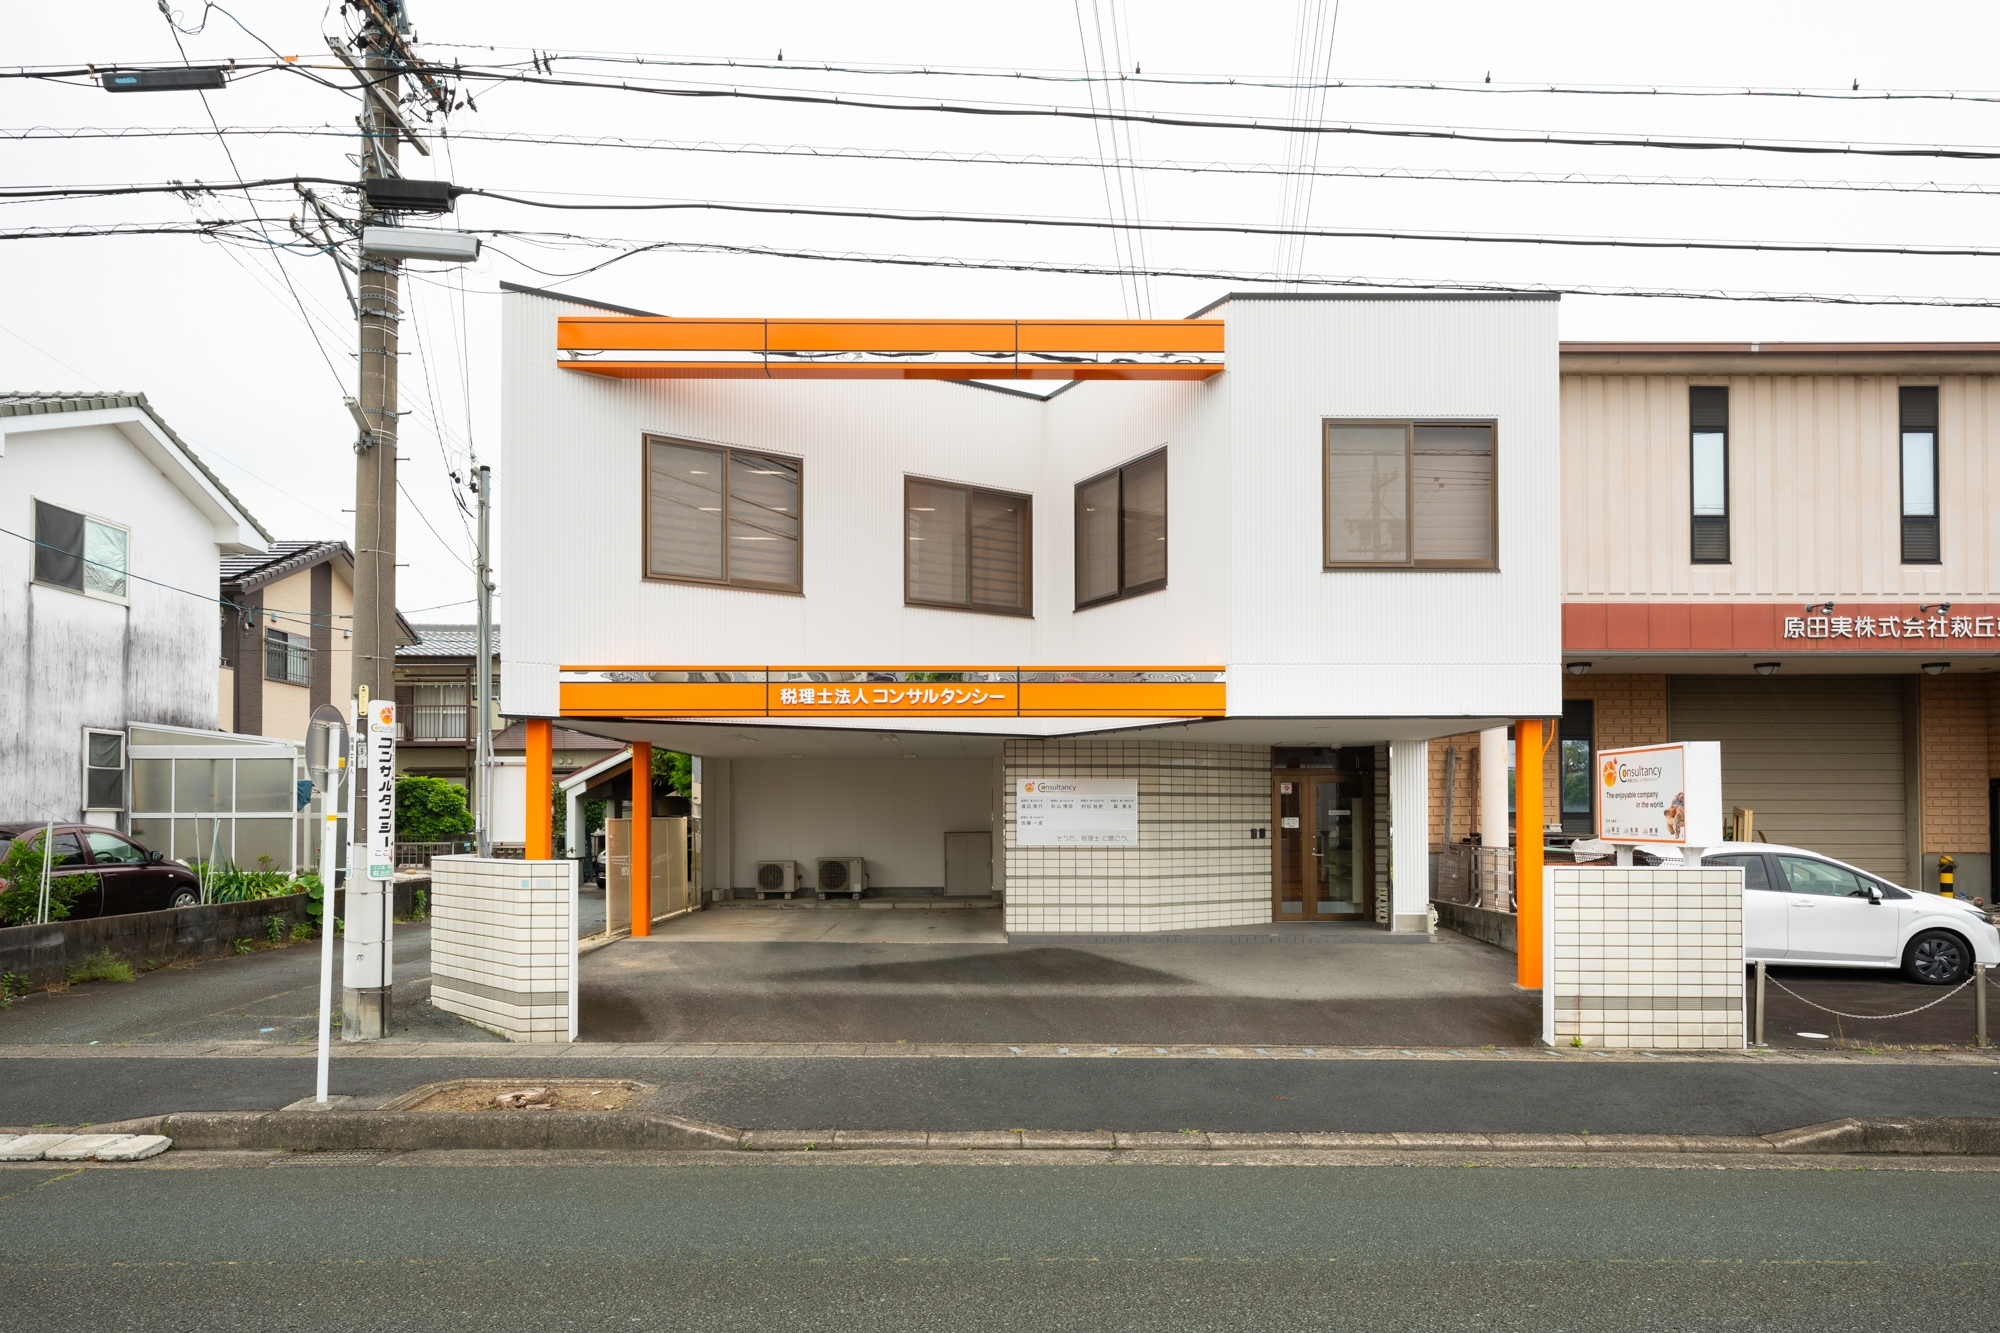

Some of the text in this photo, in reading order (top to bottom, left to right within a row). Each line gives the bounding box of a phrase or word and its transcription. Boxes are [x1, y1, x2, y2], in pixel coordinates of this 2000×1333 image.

[780, 687, 1005, 705] 税理士法人 コンサルタンシー
[1619, 763, 1662, 783] Consultancy
[378, 737, 393, 848] コンサルタンシー
[1037, 782, 1077, 793] Consultancy
[1615, 791, 1636, 800] enjoyable
[1637, 791, 1658, 799] company
[1650, 800, 1664, 808] world.
